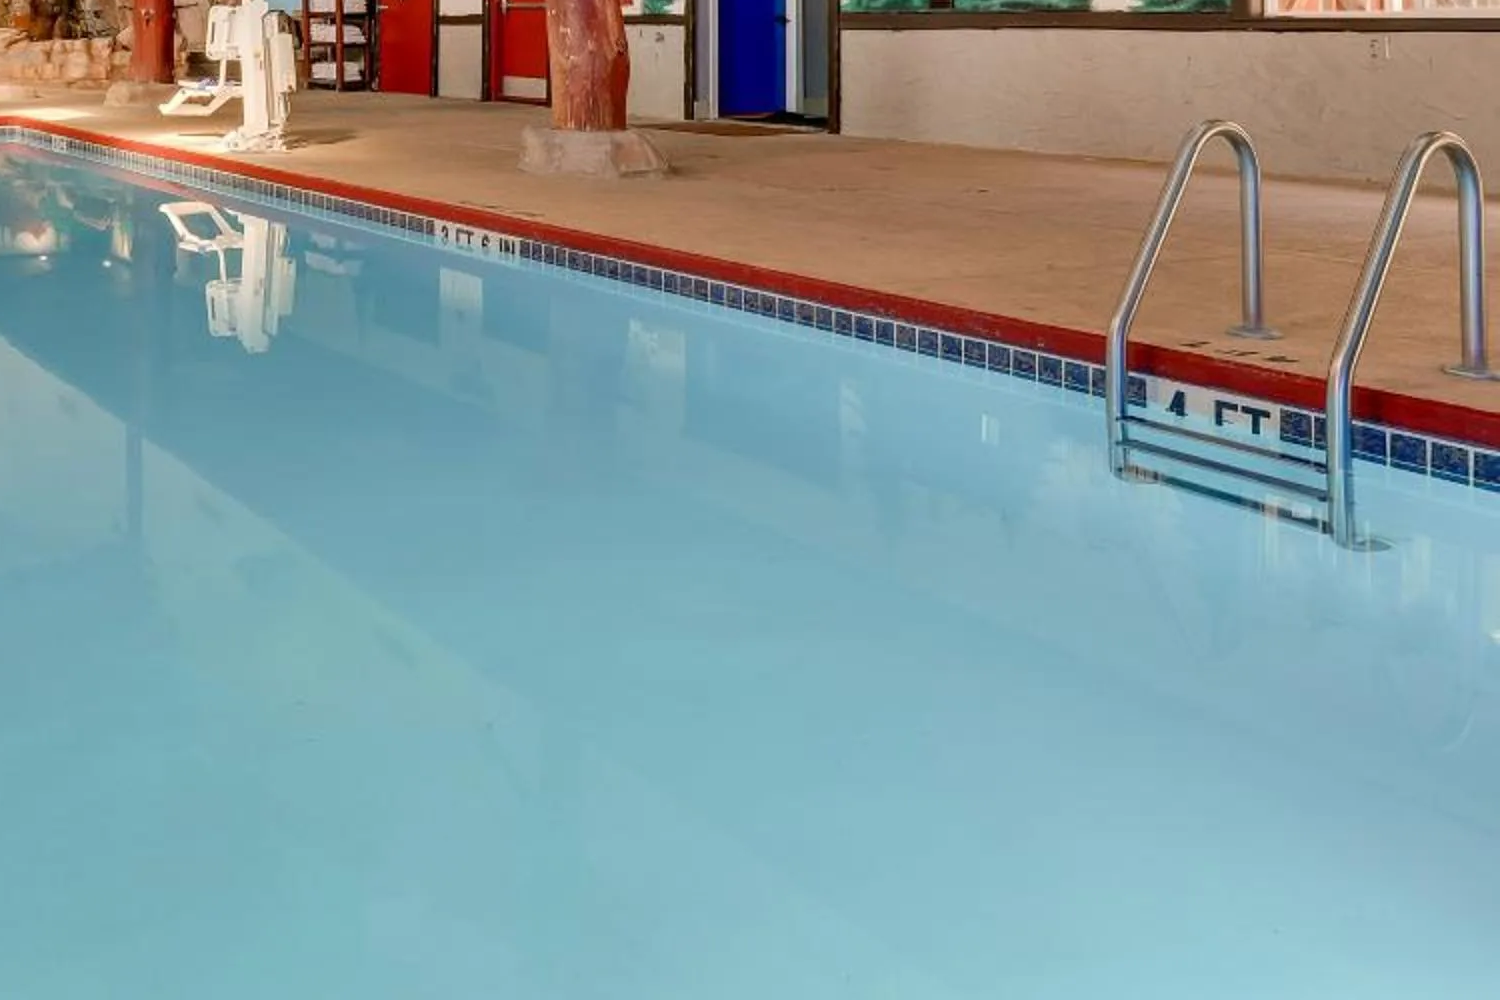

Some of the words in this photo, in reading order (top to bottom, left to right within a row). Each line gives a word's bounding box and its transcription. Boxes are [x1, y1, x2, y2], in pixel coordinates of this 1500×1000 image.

[455, 227, 474, 246] FT
[499, 235, 516, 255] IN
[1165, 389, 1188, 418] 4
[1214, 398, 1271, 435] FT
